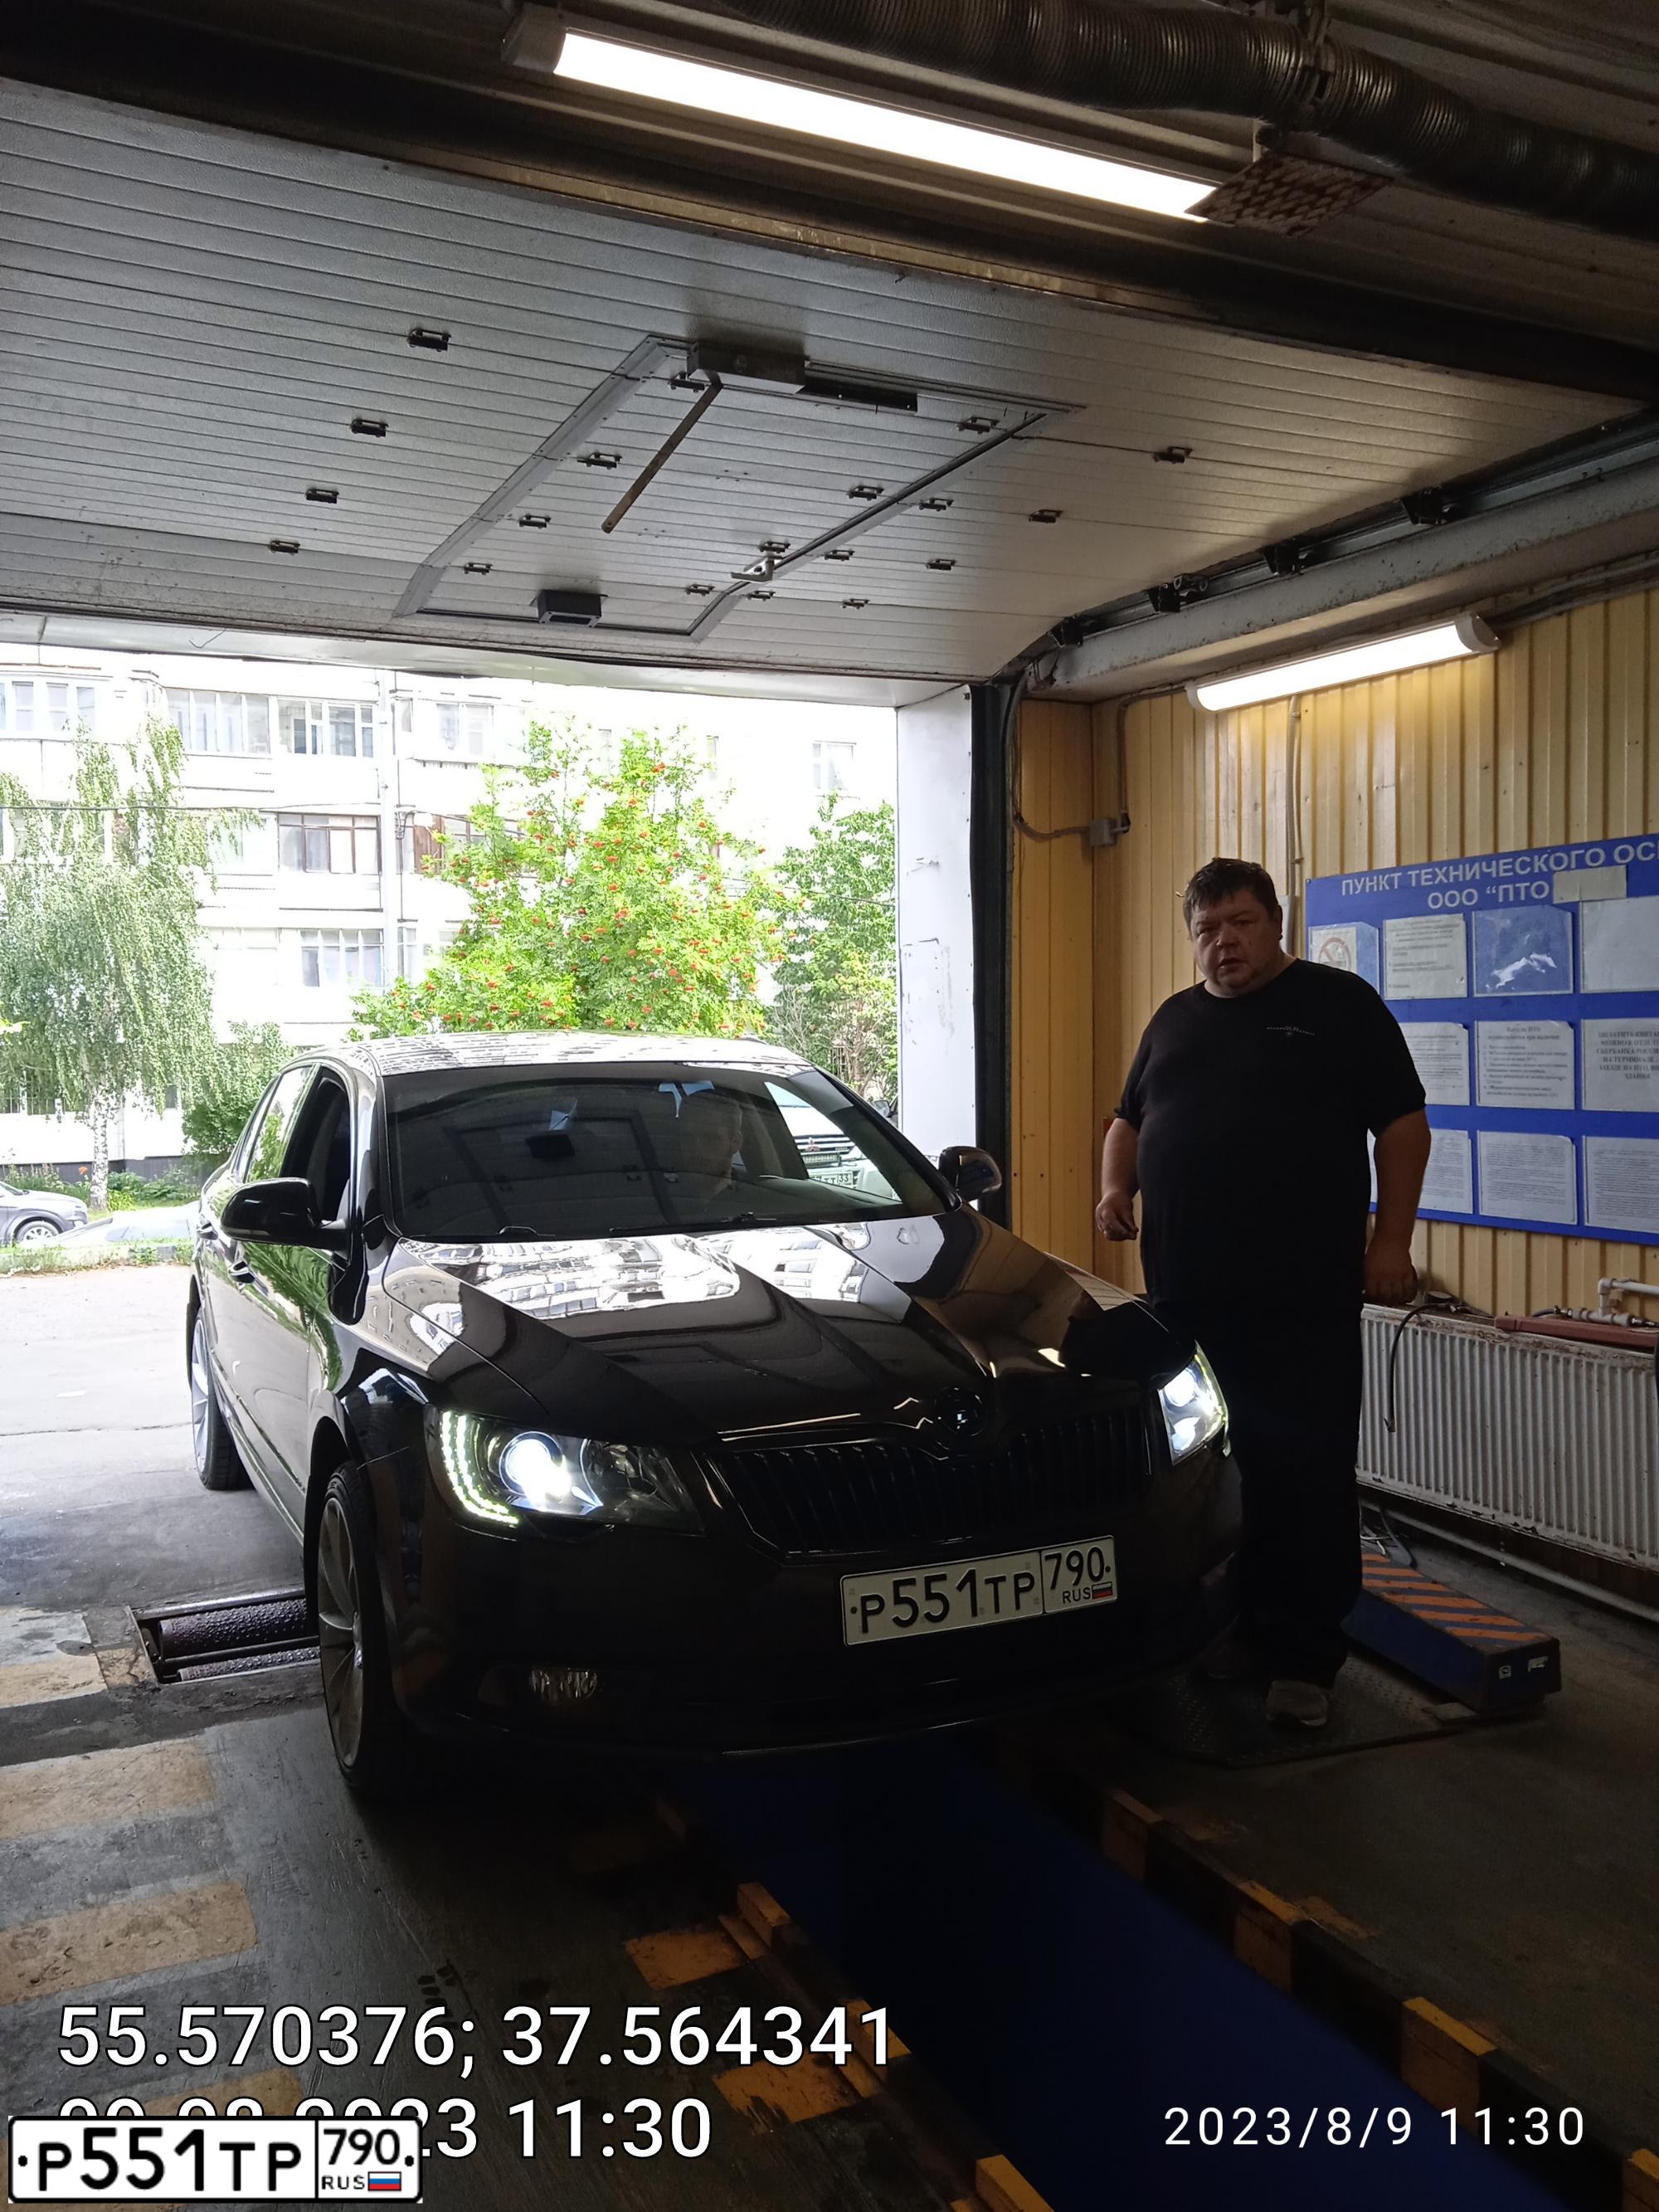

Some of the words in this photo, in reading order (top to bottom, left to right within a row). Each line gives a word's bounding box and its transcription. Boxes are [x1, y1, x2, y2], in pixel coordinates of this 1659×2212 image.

[1341, 873, 1402, 896] ПУНКТ
[1408, 848, 1606, 887] ТЕХНИЧЕСКОГО
[1613, 841, 1659, 865] ОС
[1428, 889, 1478, 909] ООО
[839, 1174, 849, 1182] 33
[860, 1568, 1035, 1634] Р551ТР
[1044, 1546, 1105, 1591] 790
[1063, 1586, 1091, 1605] RUS
